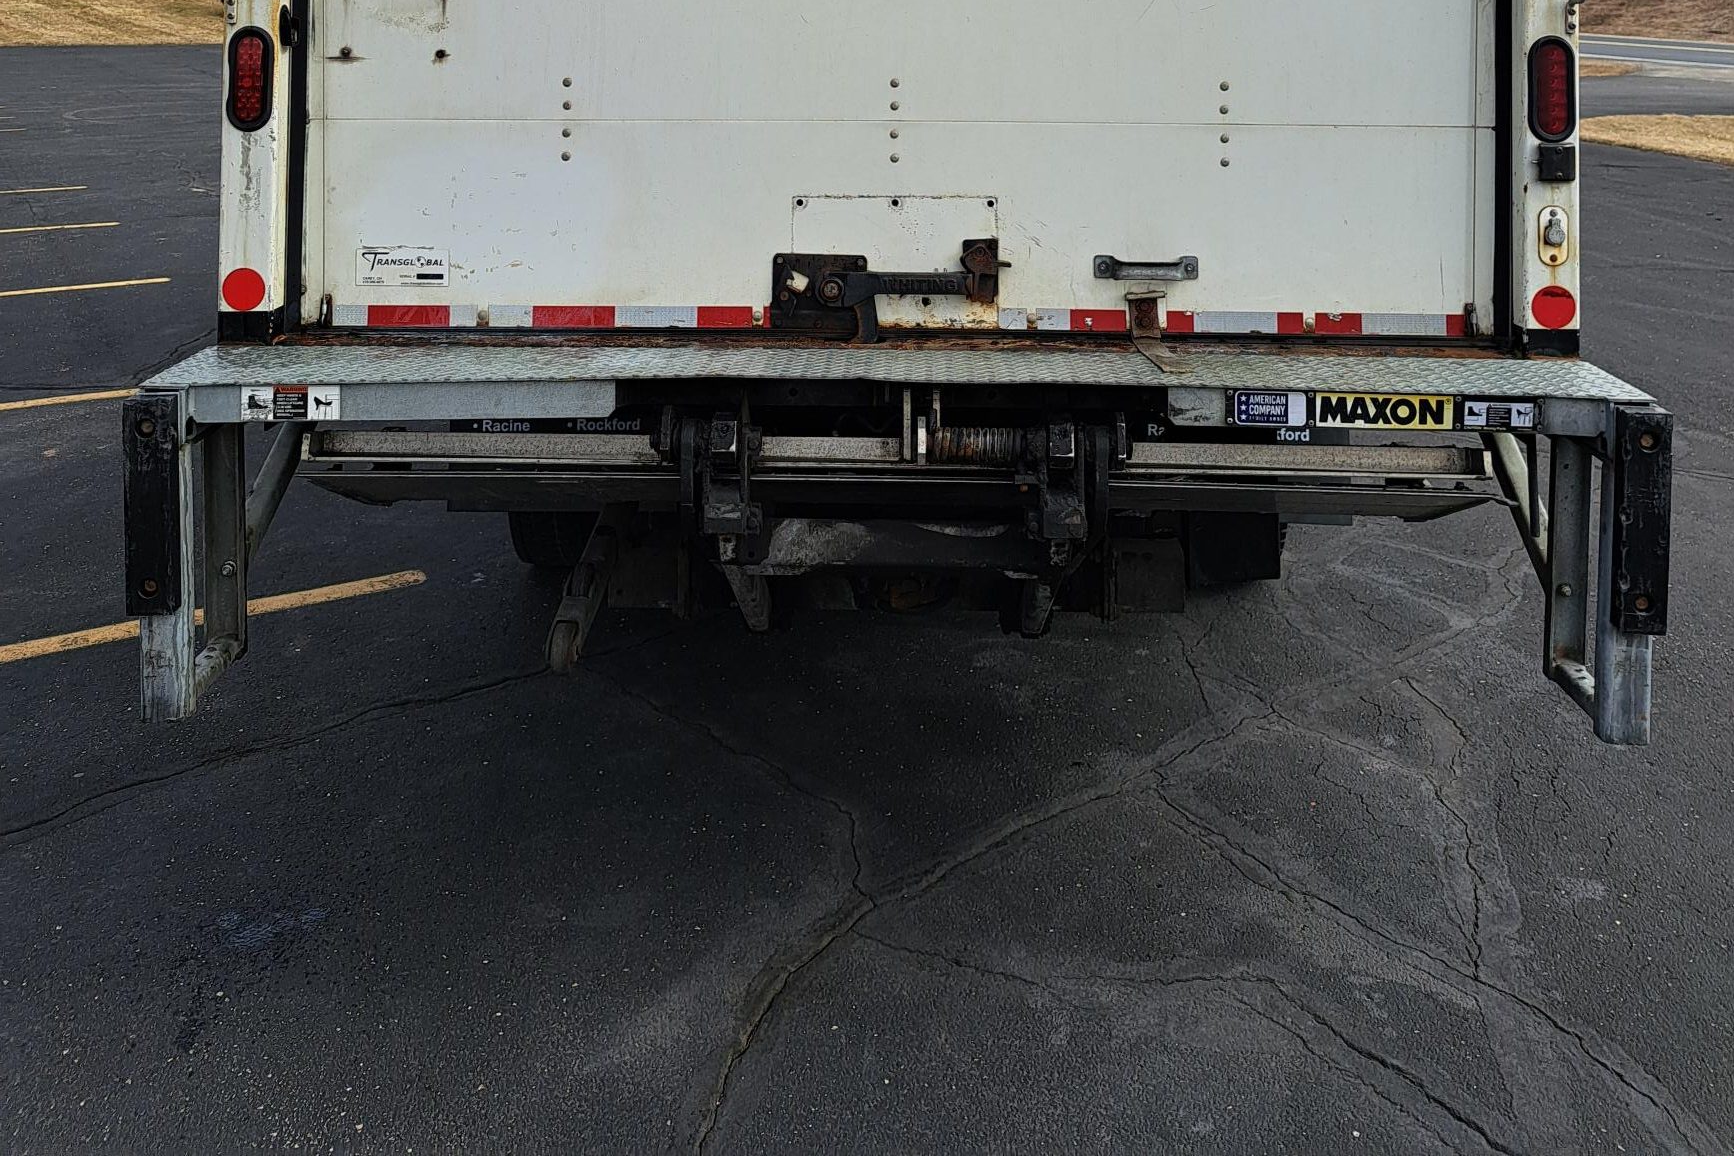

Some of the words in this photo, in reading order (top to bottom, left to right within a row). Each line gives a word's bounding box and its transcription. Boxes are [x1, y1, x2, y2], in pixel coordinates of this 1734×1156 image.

[880, 277, 958, 293] WHITING
[1249, 395, 1286, 404] AMERICAN
[1249, 405, 1286, 415] COMPANY
[1319, 396, 1445, 426] MAXON
[482, 419, 531, 432] Racine
[576, 418, 641, 431] Rockford
